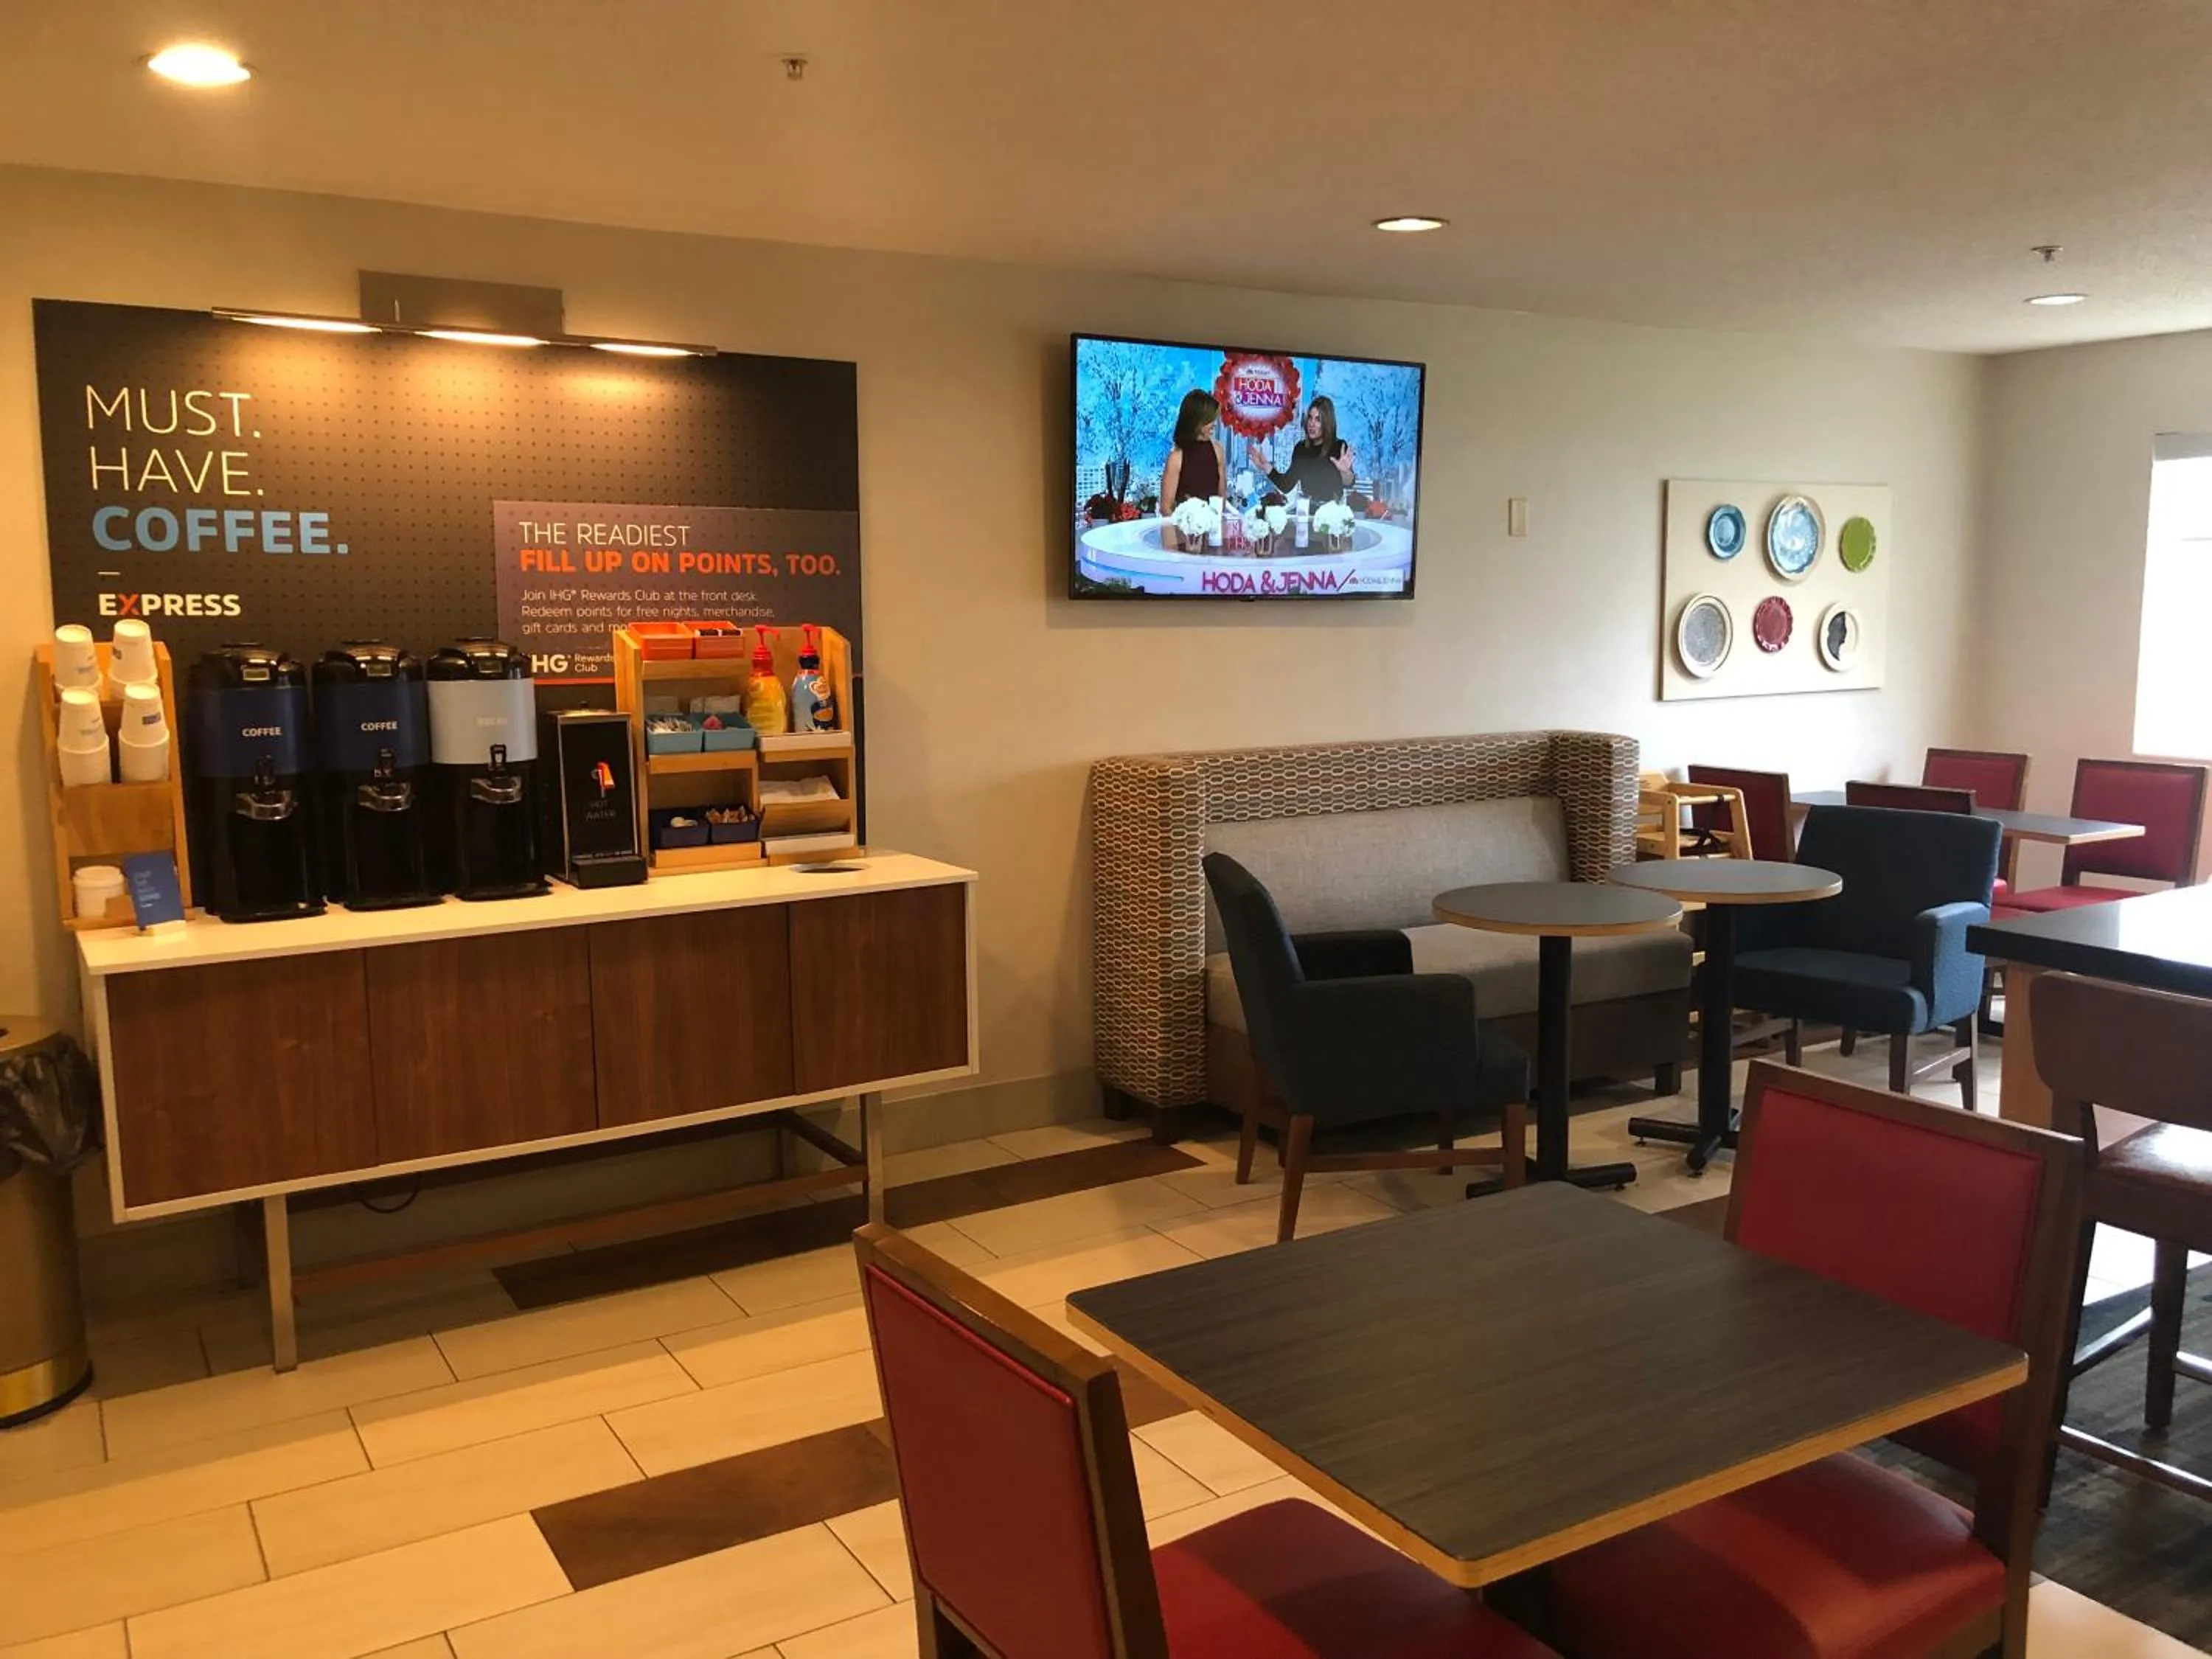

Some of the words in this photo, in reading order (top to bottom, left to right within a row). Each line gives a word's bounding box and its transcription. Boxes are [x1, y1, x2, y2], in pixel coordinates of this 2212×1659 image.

[1238, 378, 1273, 393] HODA
[86, 384, 261, 438] MUST.
[90, 446, 264, 496] HAVE.
[92, 506, 349, 554] COFFEE.
[518, 521, 567, 545] THE
[577, 522, 691, 547] READIEST
[520, 549, 577, 573] FILL
[585, 550, 622, 574] UP
[631, 551, 670, 574] ON
[678, 552, 779, 578] POINTS,
[785, 554, 841, 576] TOO.
[1202, 571, 1256, 594] HODA
[97, 593, 242, 616] EXPRESS
[521, 589, 546, 602] Join
[580, 589, 632, 602] Rewards
[634, 589, 661, 602] Club
[664, 591, 675, 601] at
[679, 591, 699, 601] the
[701, 590, 728, 601] front
[521, 605, 573, 617] Redeem
[576, 606, 613, 618] points
[616, 605, 632, 617] for
[636, 605, 659, 617] free
[521, 621, 542, 634] gift
[545, 622, 578, 633] cards
[581, 621, 604, 633] and
[574, 663, 598, 673] Club
[242, 726, 282, 737] COFFEE
[361, 720, 399, 731] COFFEE
